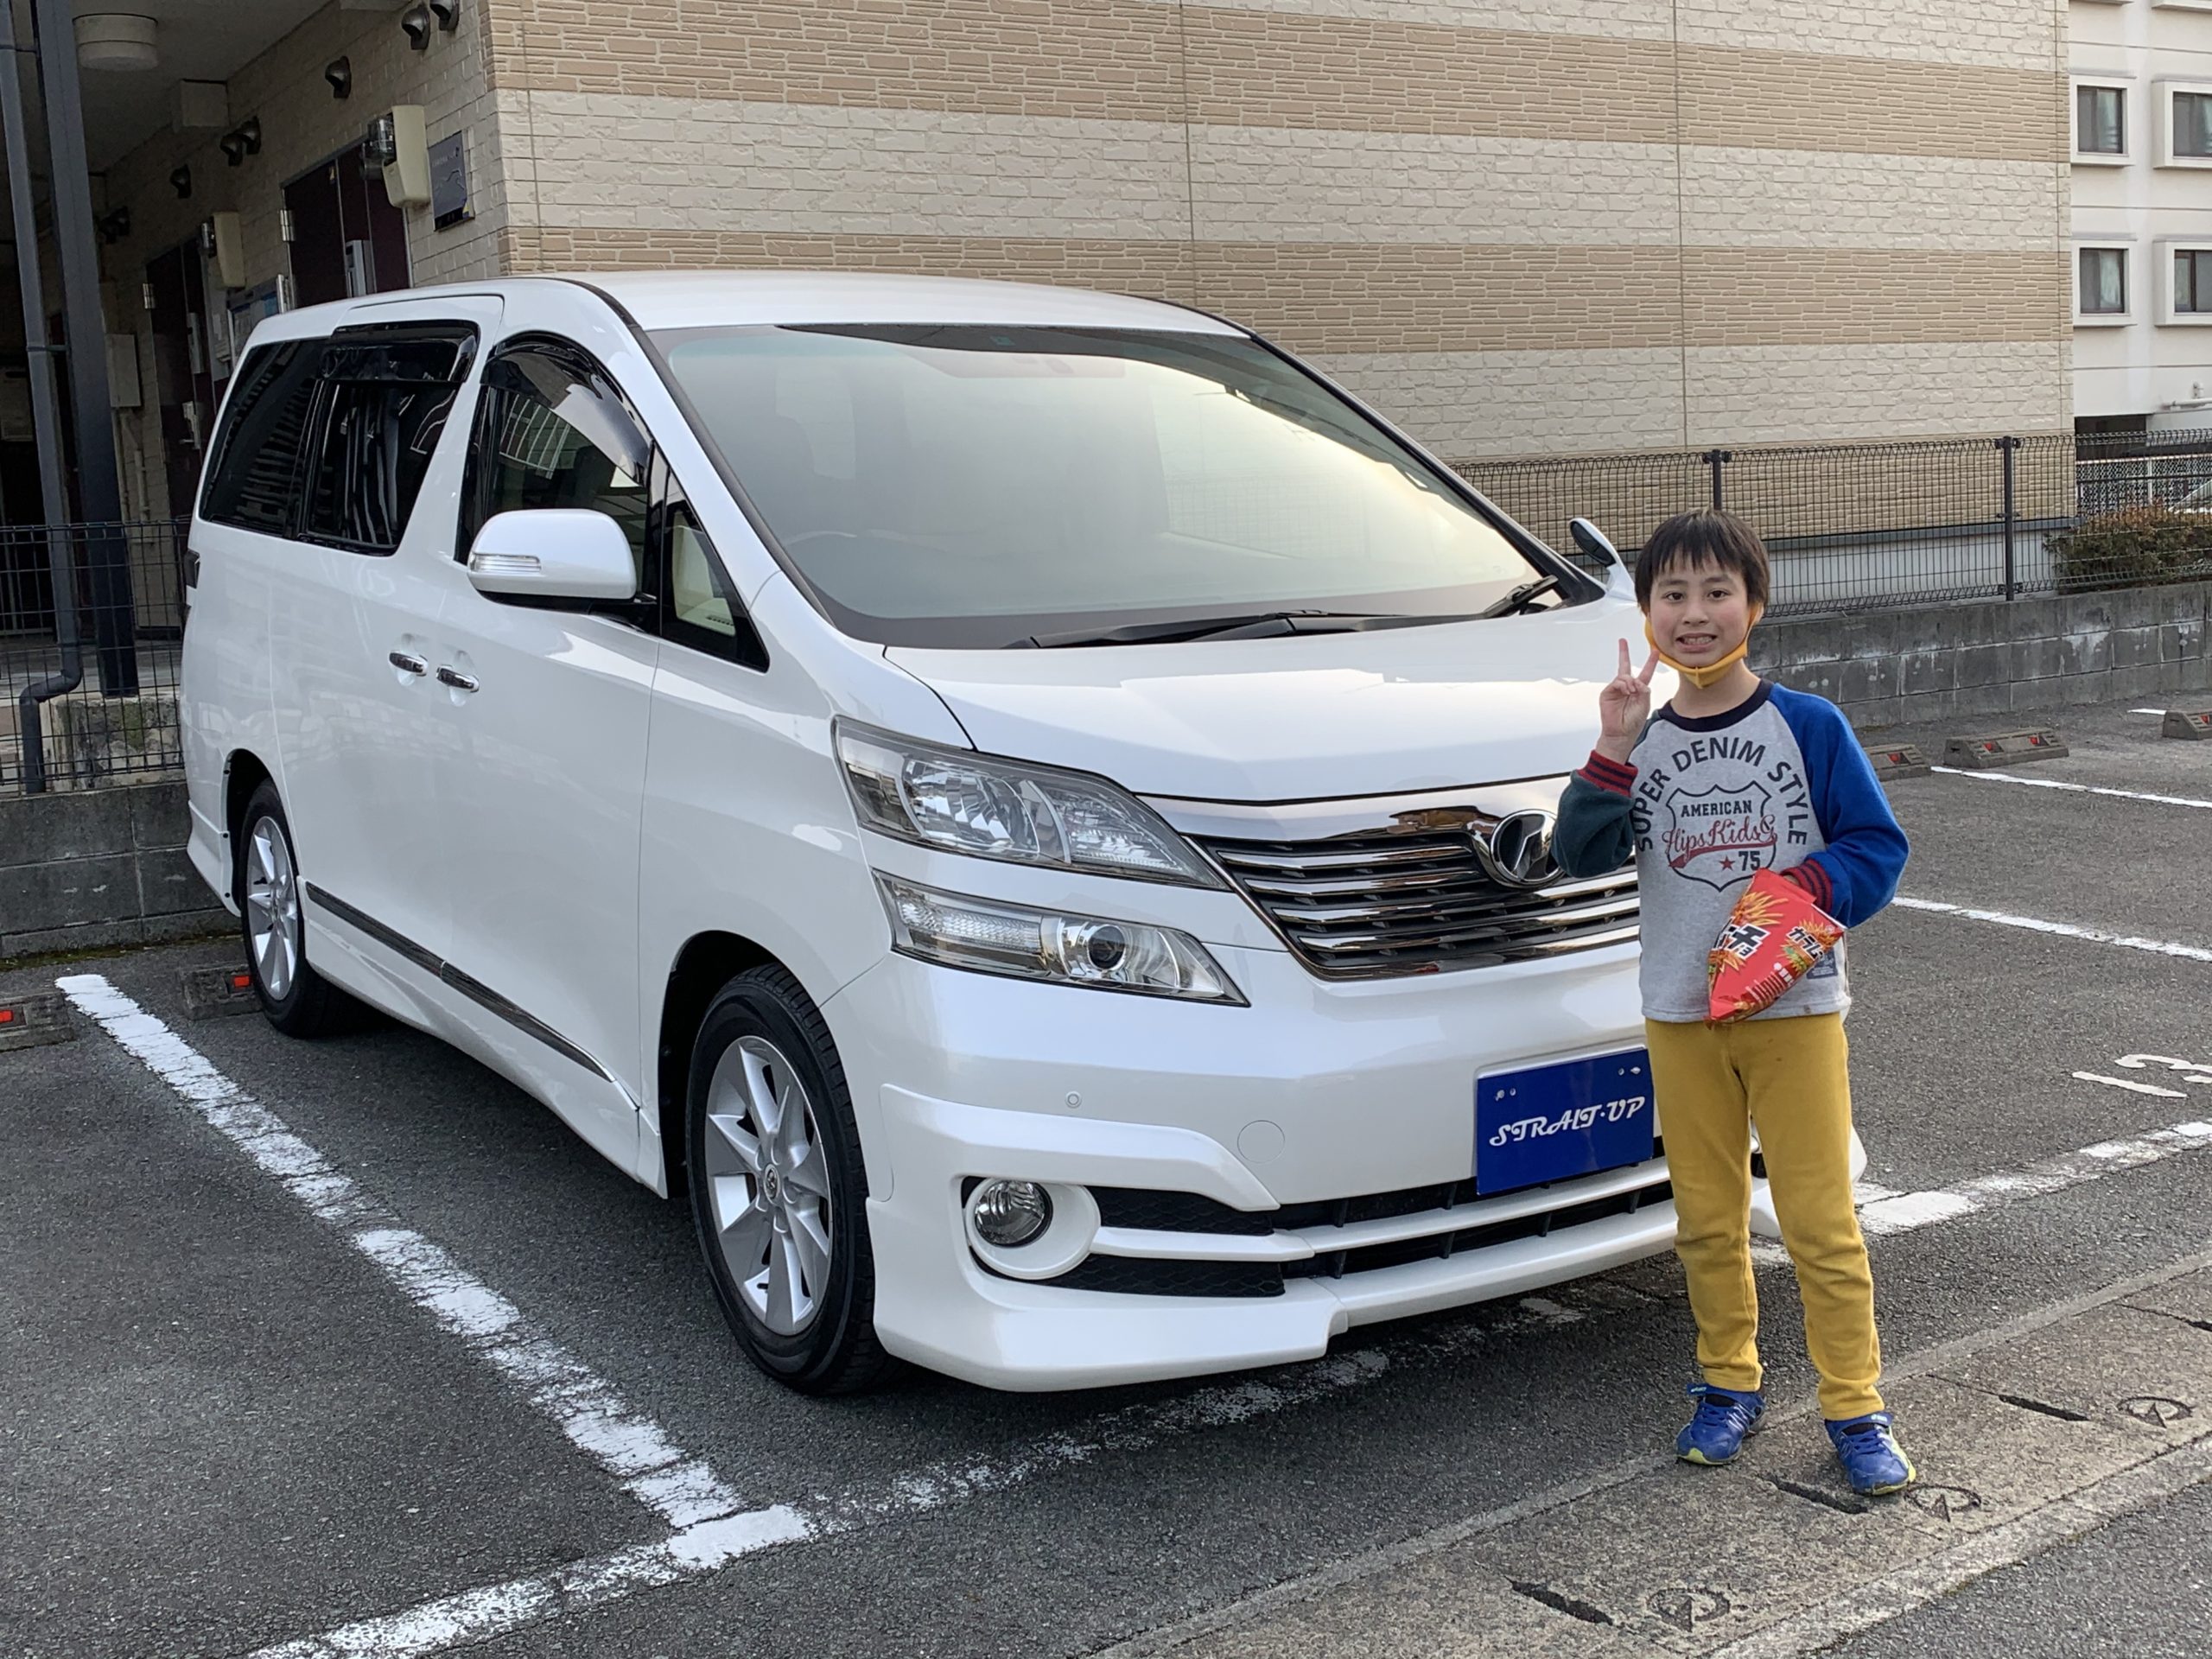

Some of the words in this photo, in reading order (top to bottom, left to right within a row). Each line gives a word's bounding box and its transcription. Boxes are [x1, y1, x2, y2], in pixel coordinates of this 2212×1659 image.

[1630, 769, 1671, 852] SUPER
[1672, 737, 1765, 772] DENIM
[1767, 761, 1808, 845] STYLE
[1681, 799, 1752, 817] AMERICAN
[1738, 850, 1760, 871] 75
